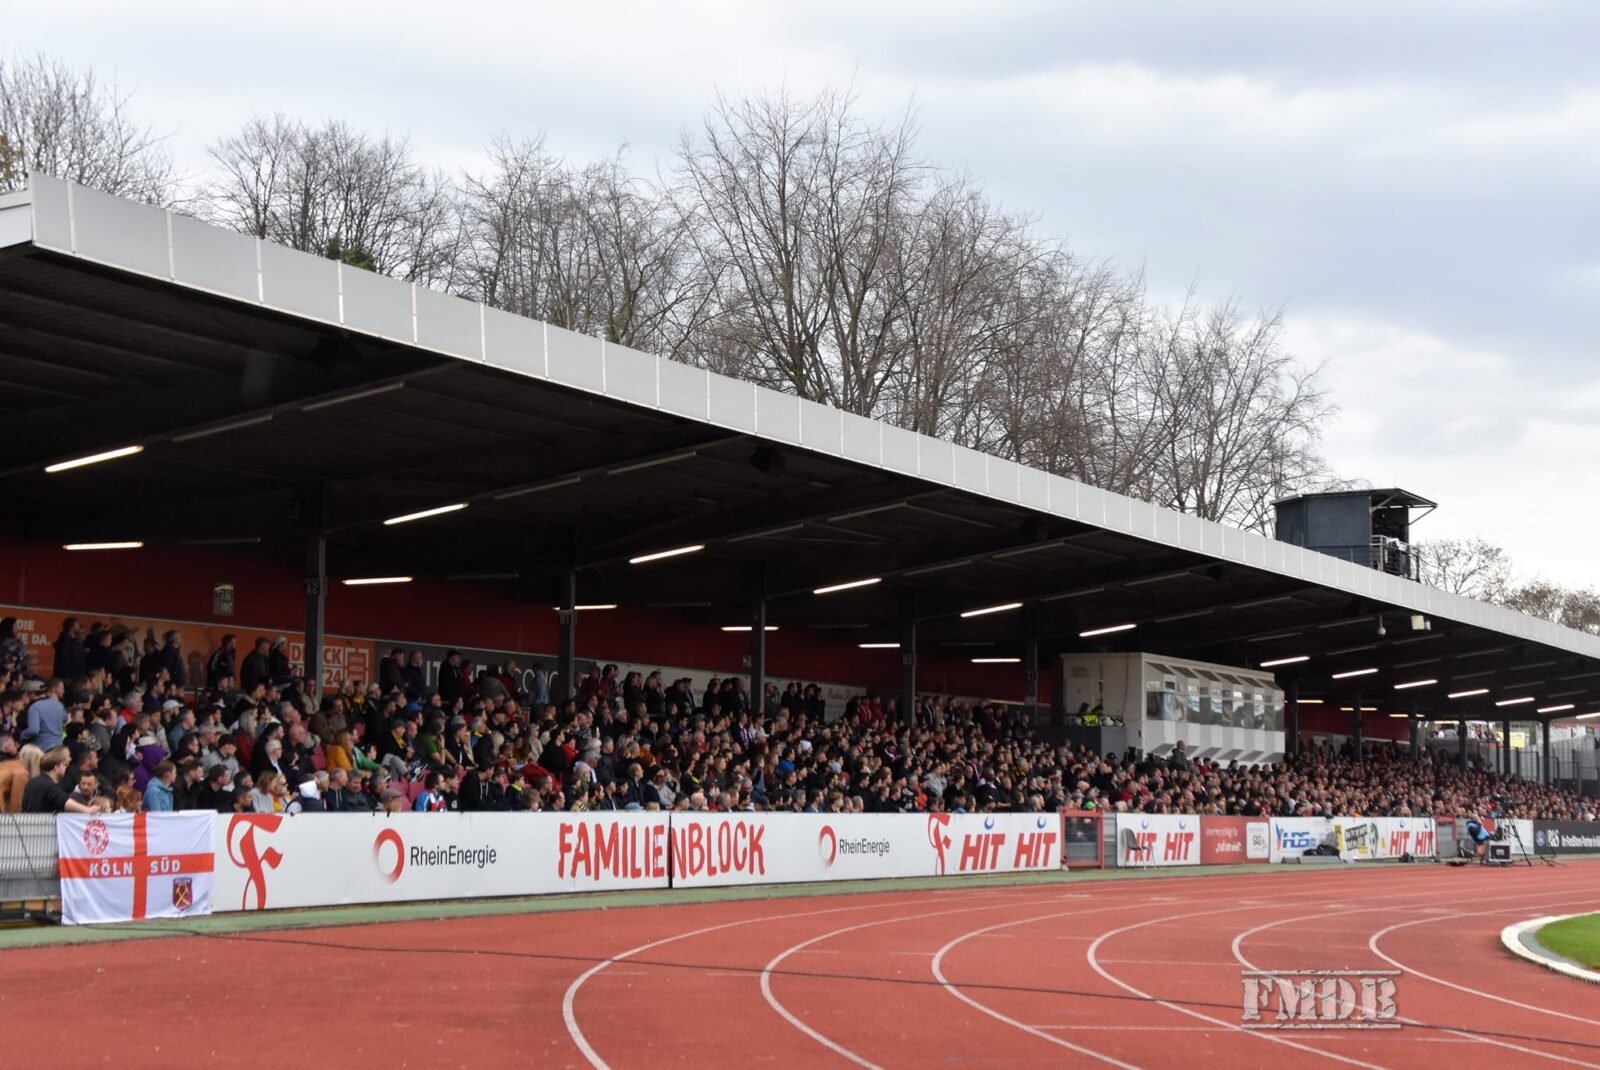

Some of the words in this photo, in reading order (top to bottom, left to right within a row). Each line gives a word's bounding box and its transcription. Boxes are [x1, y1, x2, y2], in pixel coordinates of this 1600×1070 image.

[558, 820, 765, 881] FAMILIENBLOCK
[839, 838, 890, 856] RheinEnergie
[959, 833, 1006, 871] HIT
[1013, 832, 1057, 868] HIT
[1164, 832, 1195, 861] HIT
[1389, 831, 1410, 856] HIT
[1415, 831, 1434, 856] HIT
[89, 859, 133, 877] KÖLN
[150, 859, 182, 874] SÜD
[410, 845, 497, 869] RheinEnergie
